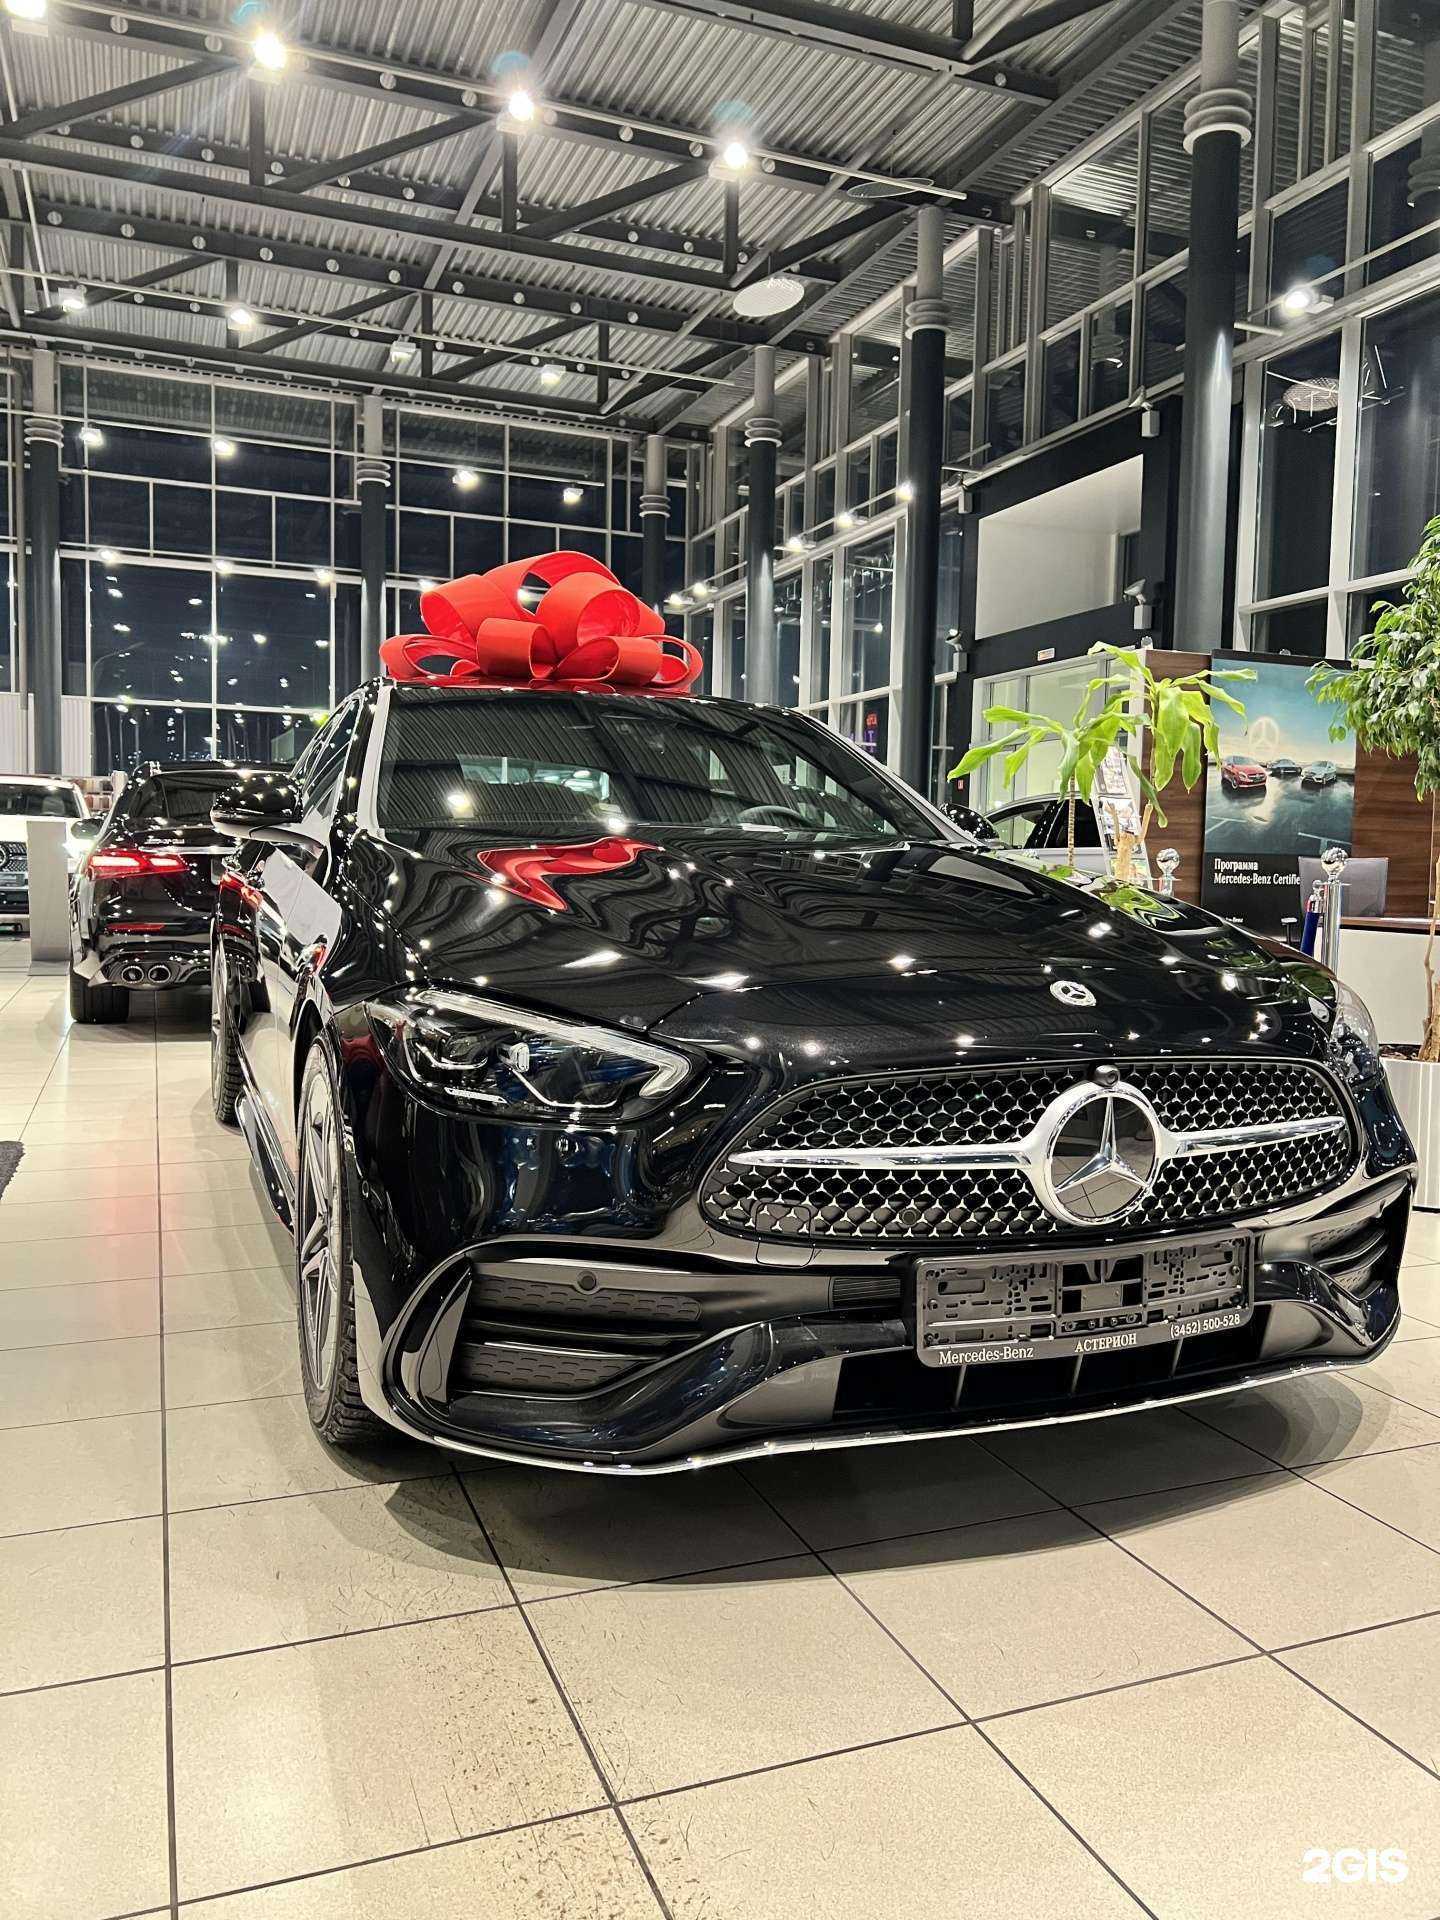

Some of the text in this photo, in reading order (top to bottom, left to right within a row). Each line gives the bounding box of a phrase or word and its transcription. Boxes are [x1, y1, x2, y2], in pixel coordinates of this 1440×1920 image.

[1214, 858, 1259, 872] Программа
[1214, 873, 1301, 885] Mercedes-Benz Certifie
[939, 1313, 1241, 1365] Mercedes-Benz АСТЕРИОН (3452) 500-528
